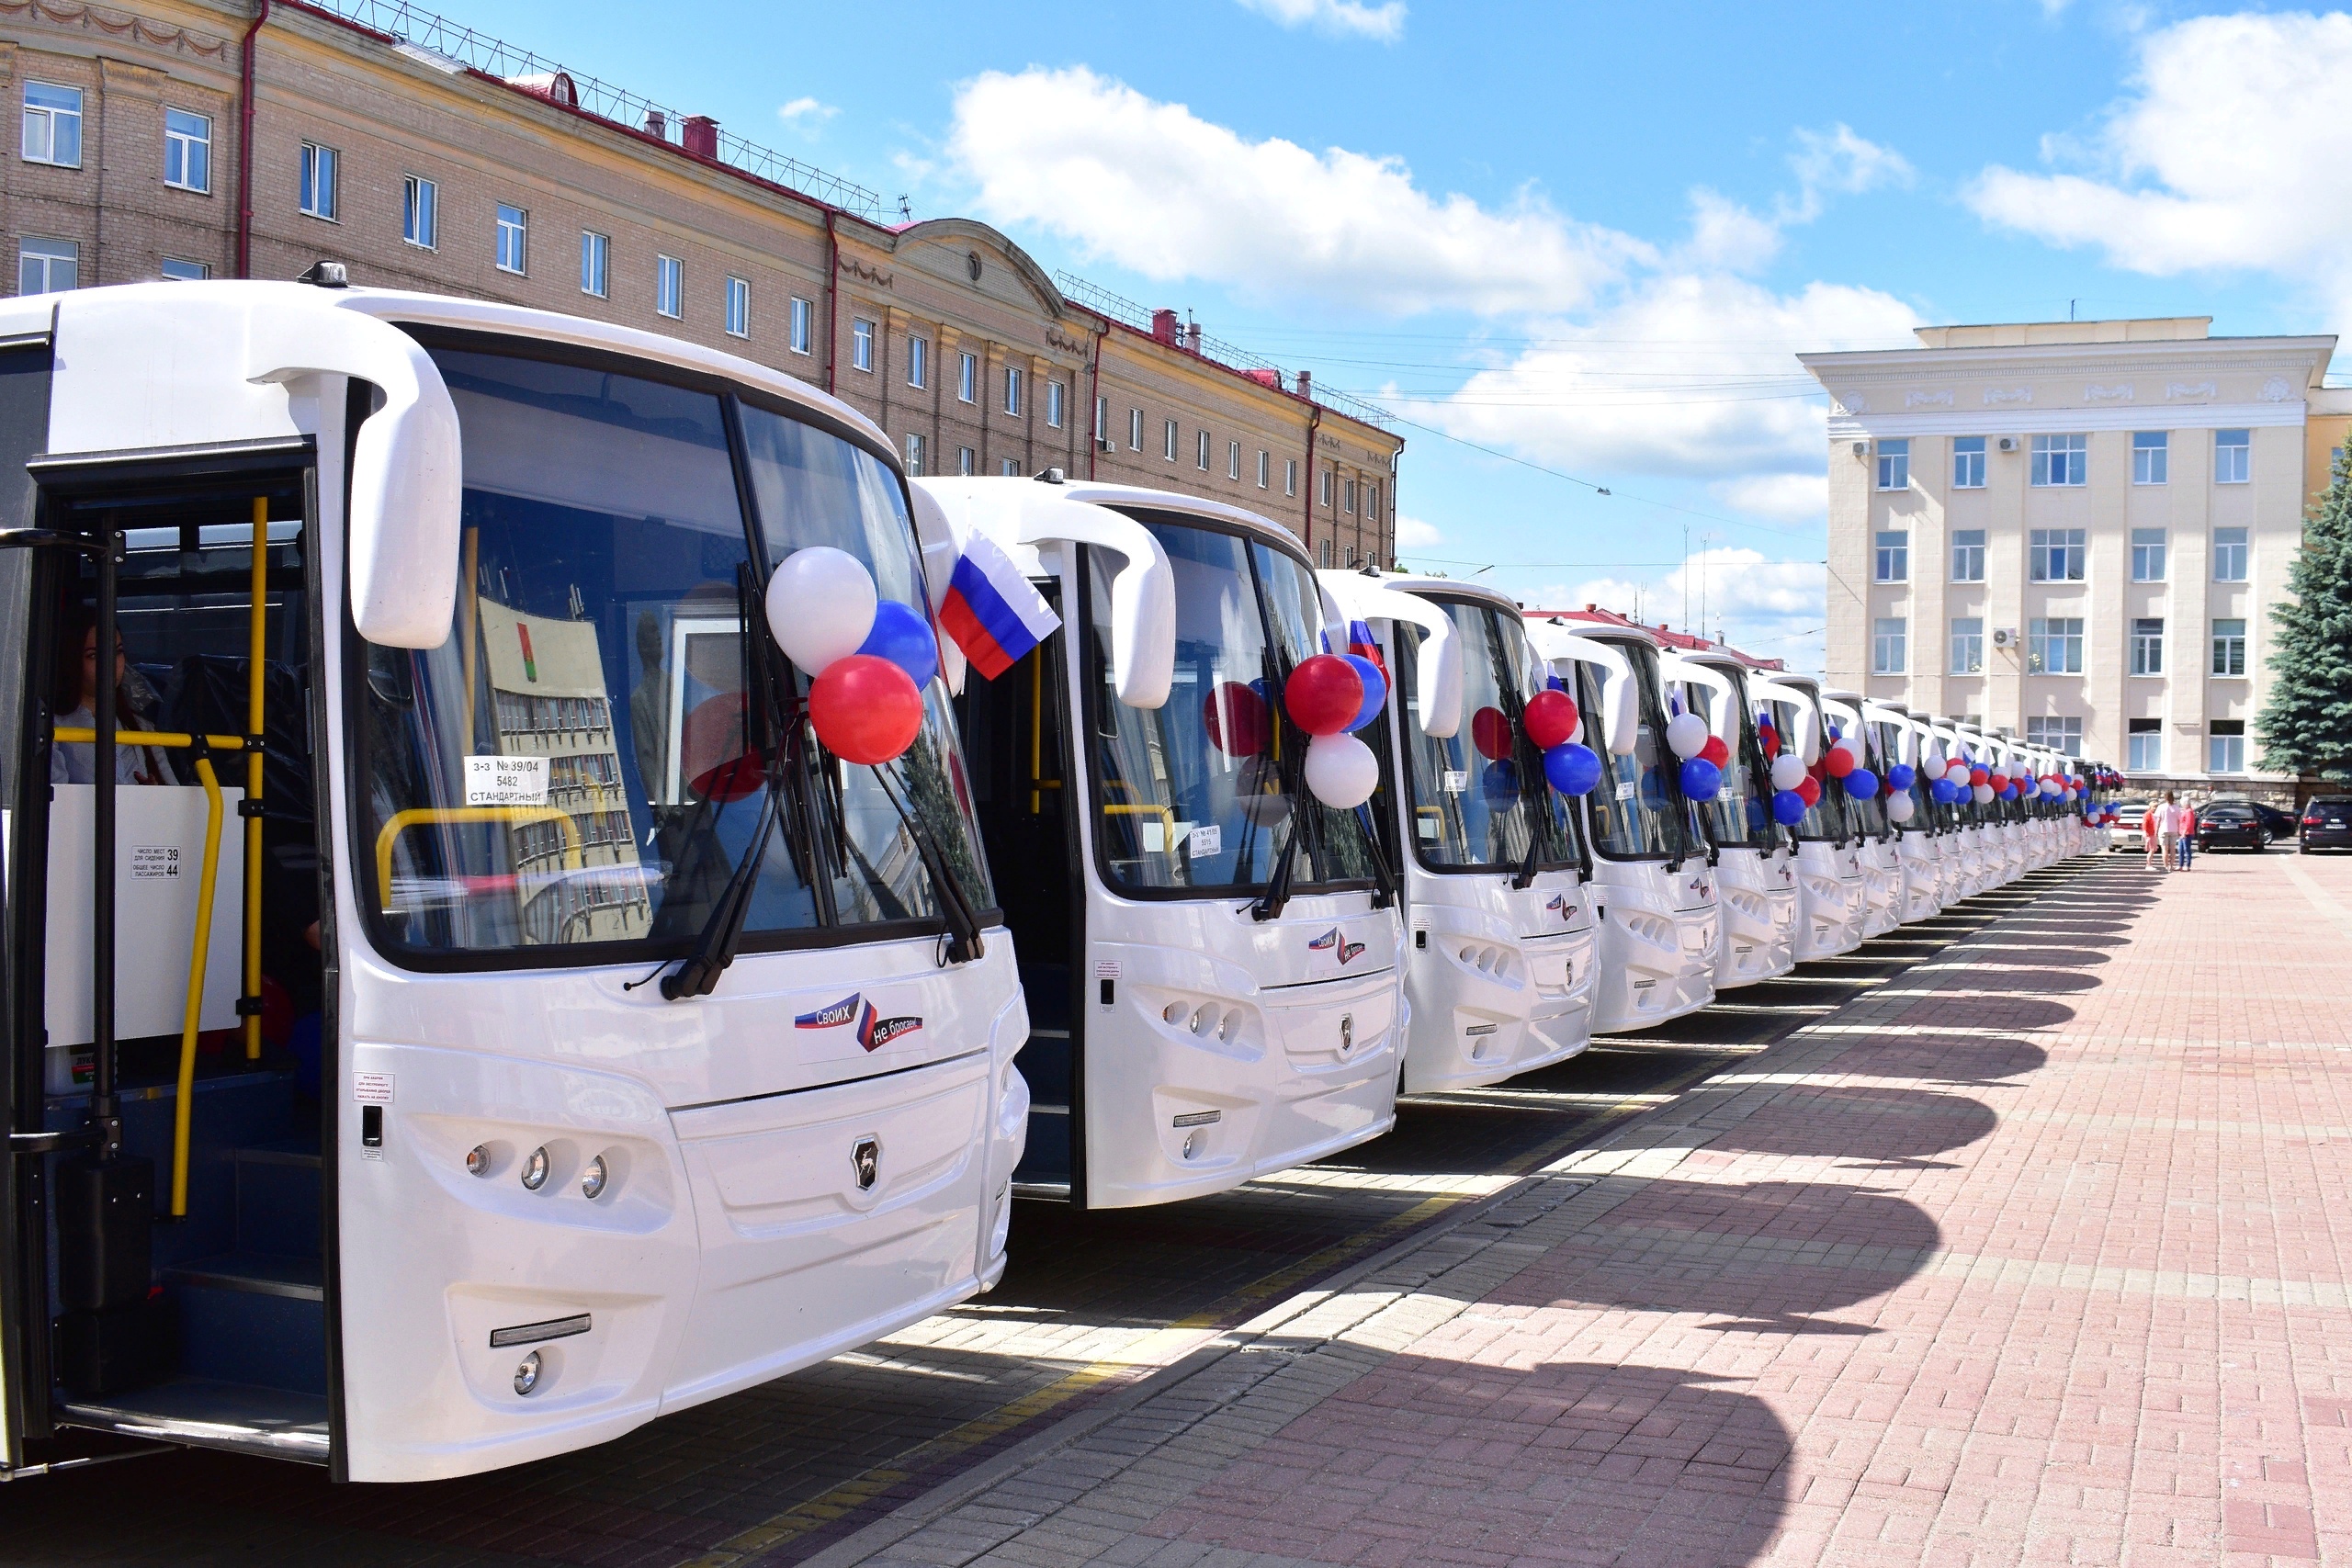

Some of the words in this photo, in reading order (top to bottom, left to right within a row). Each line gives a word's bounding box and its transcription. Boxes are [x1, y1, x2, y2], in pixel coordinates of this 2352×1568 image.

[511, 761, 538, 772] 39/04
[496, 776, 518, 786] 5482
[470, 792, 541, 802] СТАНДАРТНЫЙ
[167, 849, 178, 861] 39
[166, 864, 178, 876] 44
[816, 1005, 851, 1025] Своих
[874, 1029, 888, 1044] не
